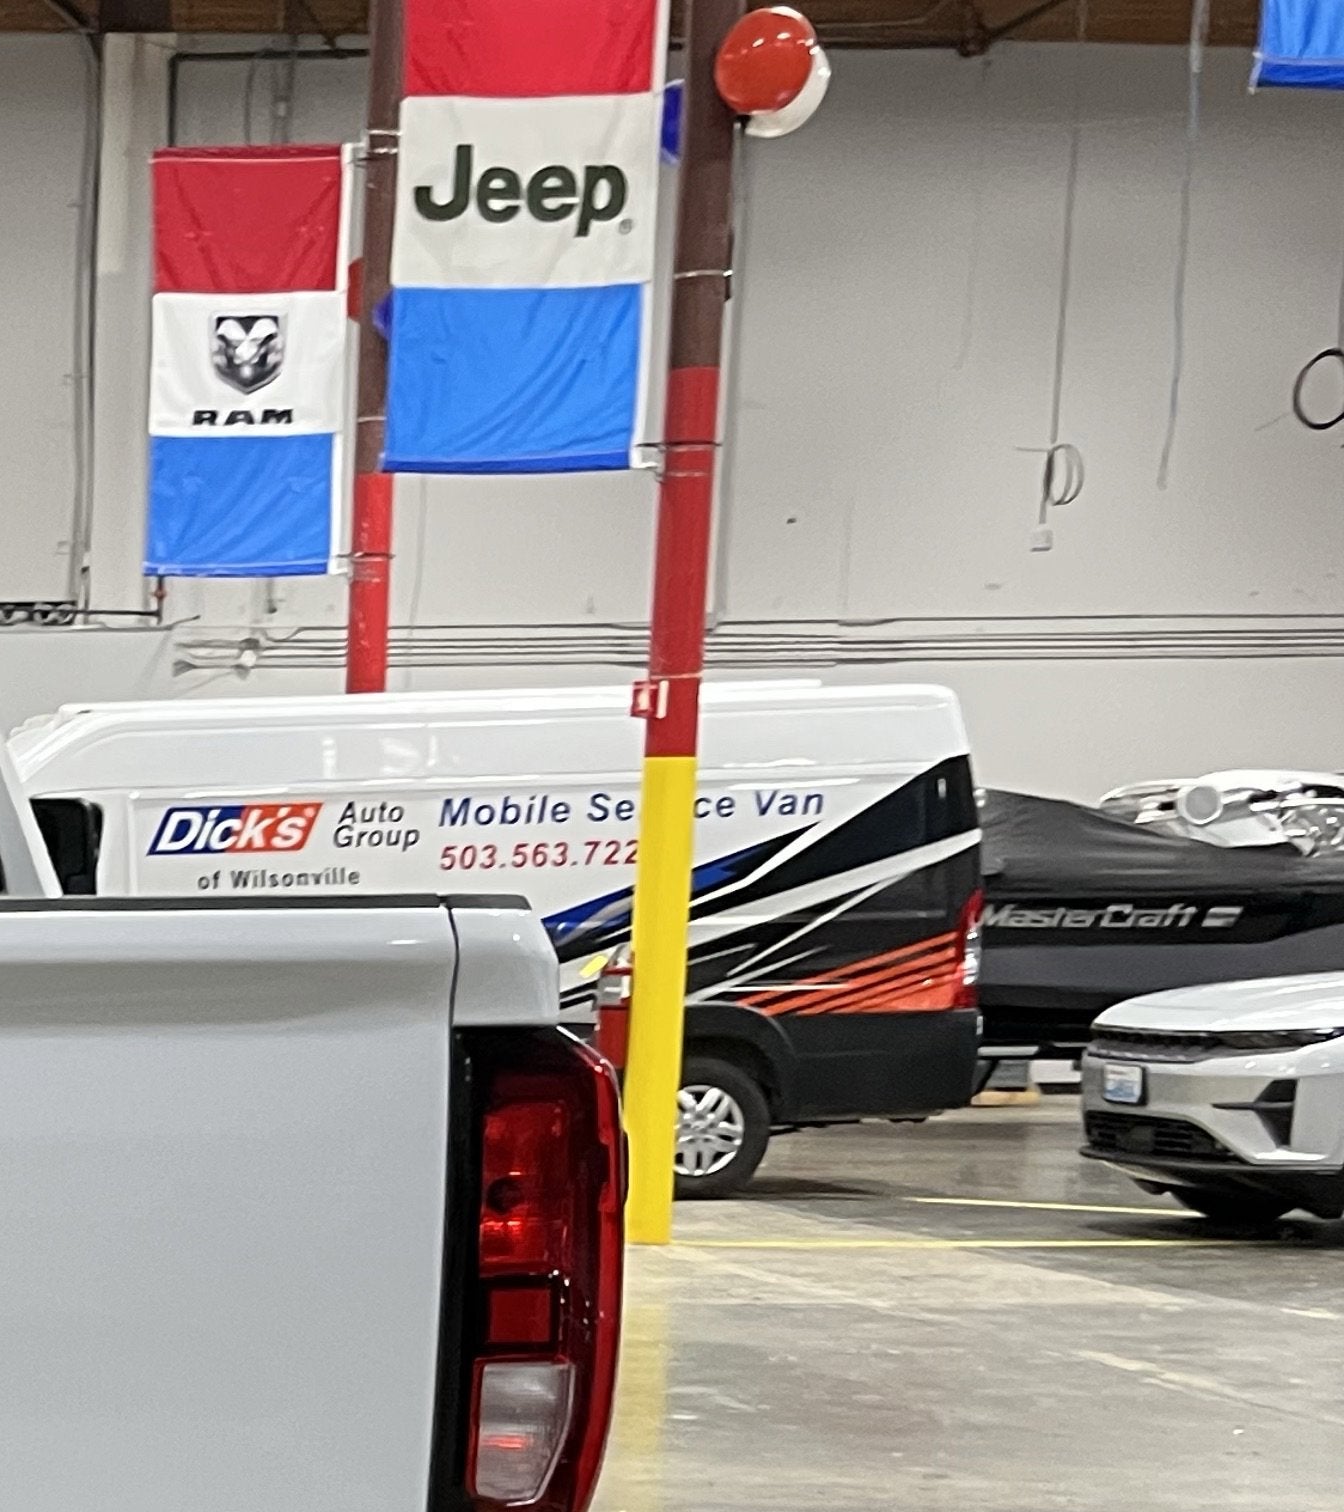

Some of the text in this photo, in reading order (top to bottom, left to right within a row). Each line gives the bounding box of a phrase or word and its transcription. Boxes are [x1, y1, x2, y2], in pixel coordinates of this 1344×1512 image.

[414, 143, 628, 238] Jeep
[192, 408, 294, 426] RAM
[438, 789, 824, 828] Mobile Sece Van
[154, 800, 405, 852] Dick's Auto
[333, 825, 421, 852] Group
[438, 839, 640, 871] 503.563.722
[197, 866, 361, 890] of Wilsonville
[981, 902, 1199, 929] MasterCraft
